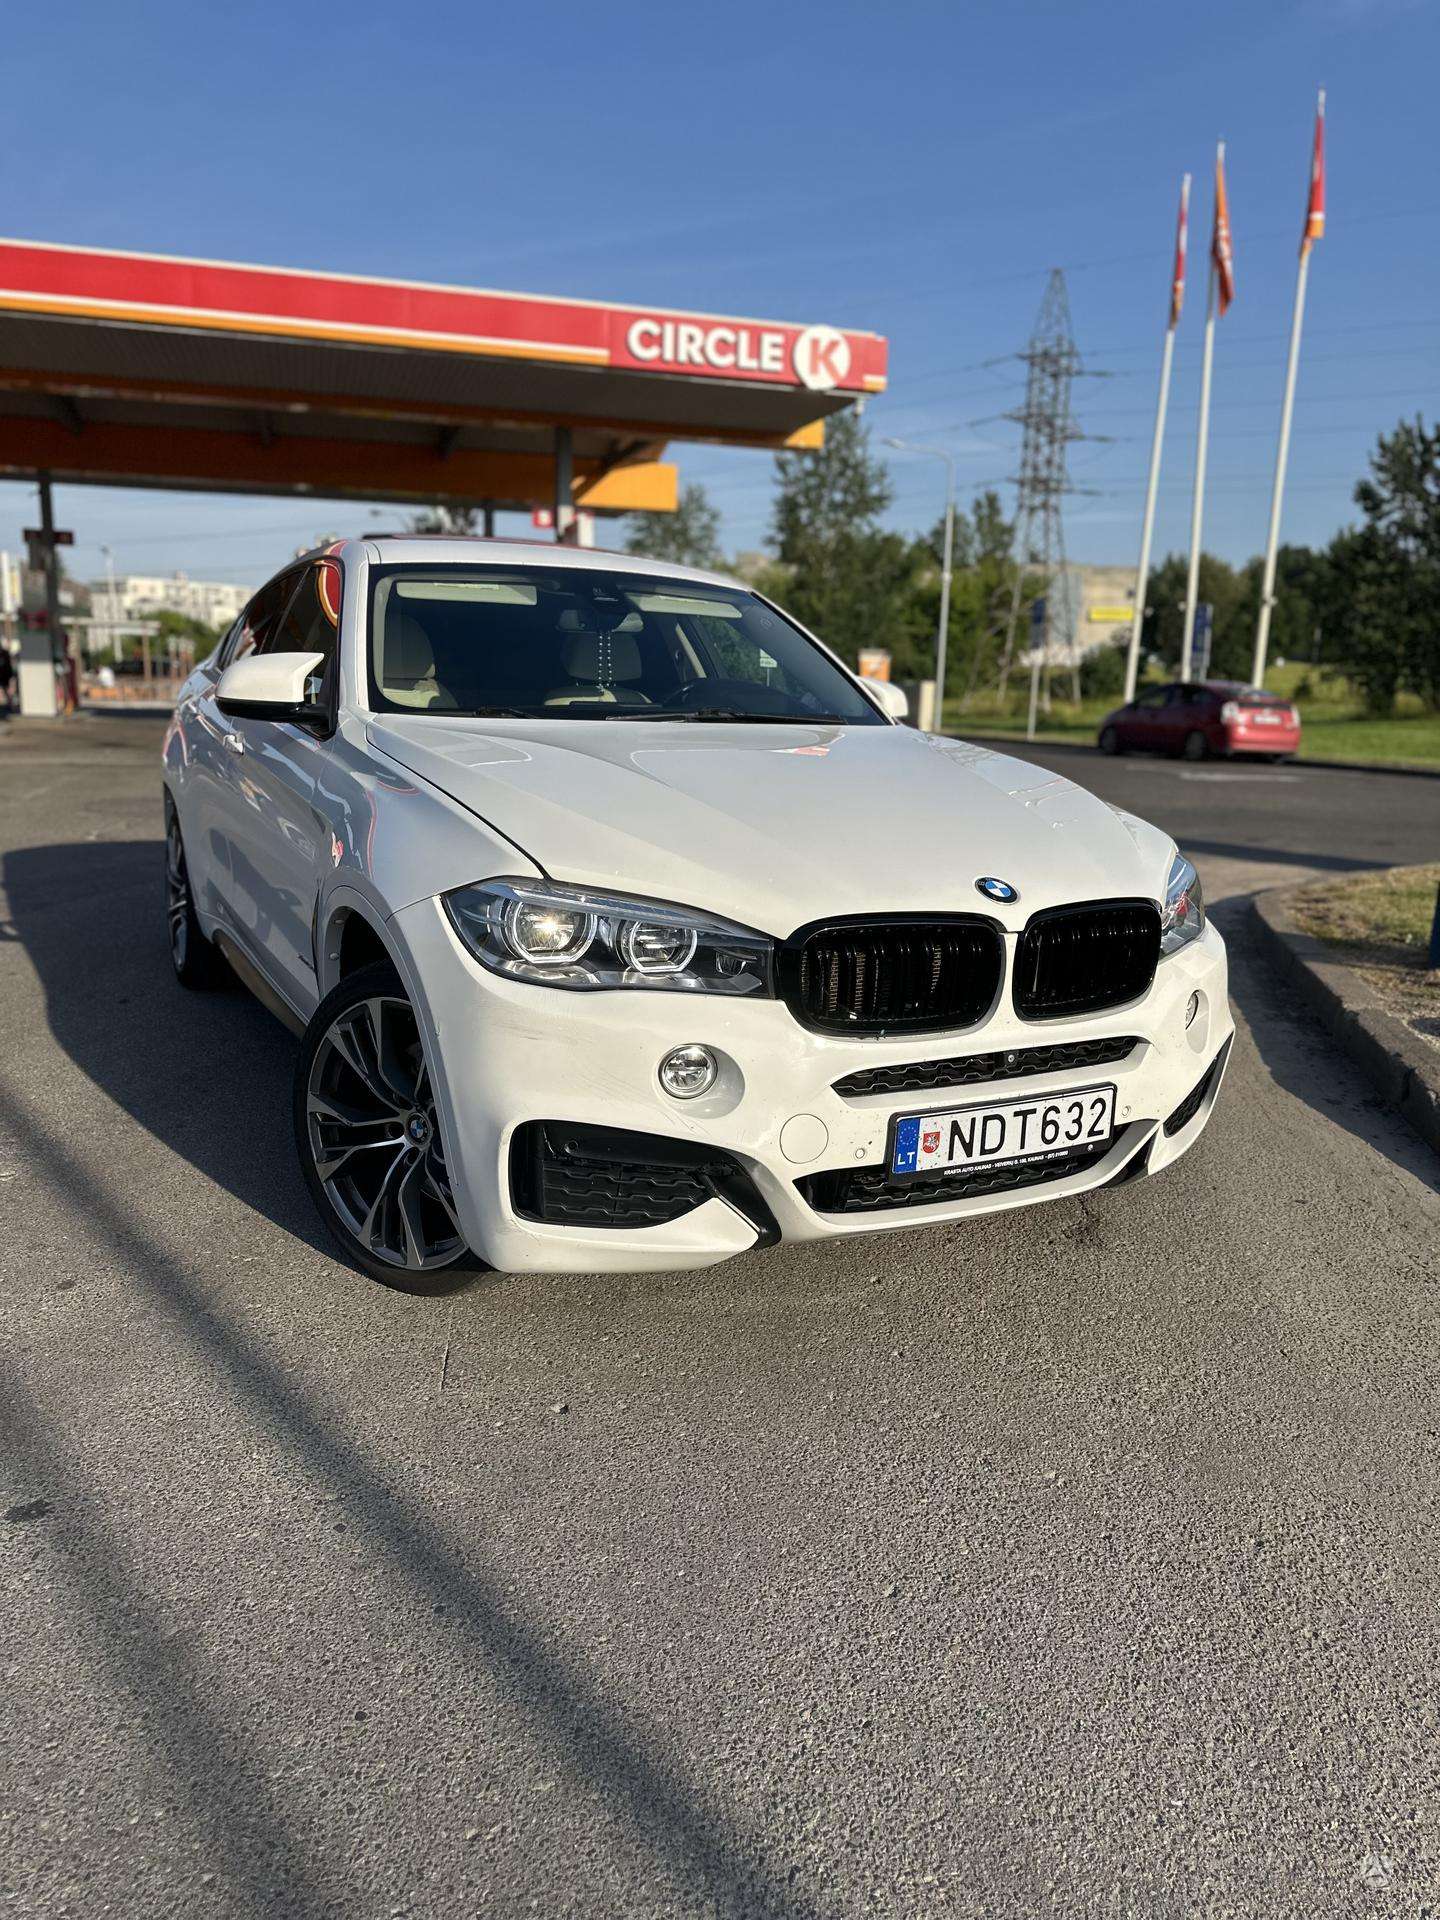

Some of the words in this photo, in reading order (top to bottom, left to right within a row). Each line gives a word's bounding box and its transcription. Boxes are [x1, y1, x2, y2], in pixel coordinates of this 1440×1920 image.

[627, 318, 784, 372] CIRCLE
[808, 336, 843, 385] K
[897, 1151, 916, 1165] LT
[948, 1097, 1107, 1161] NDT632
